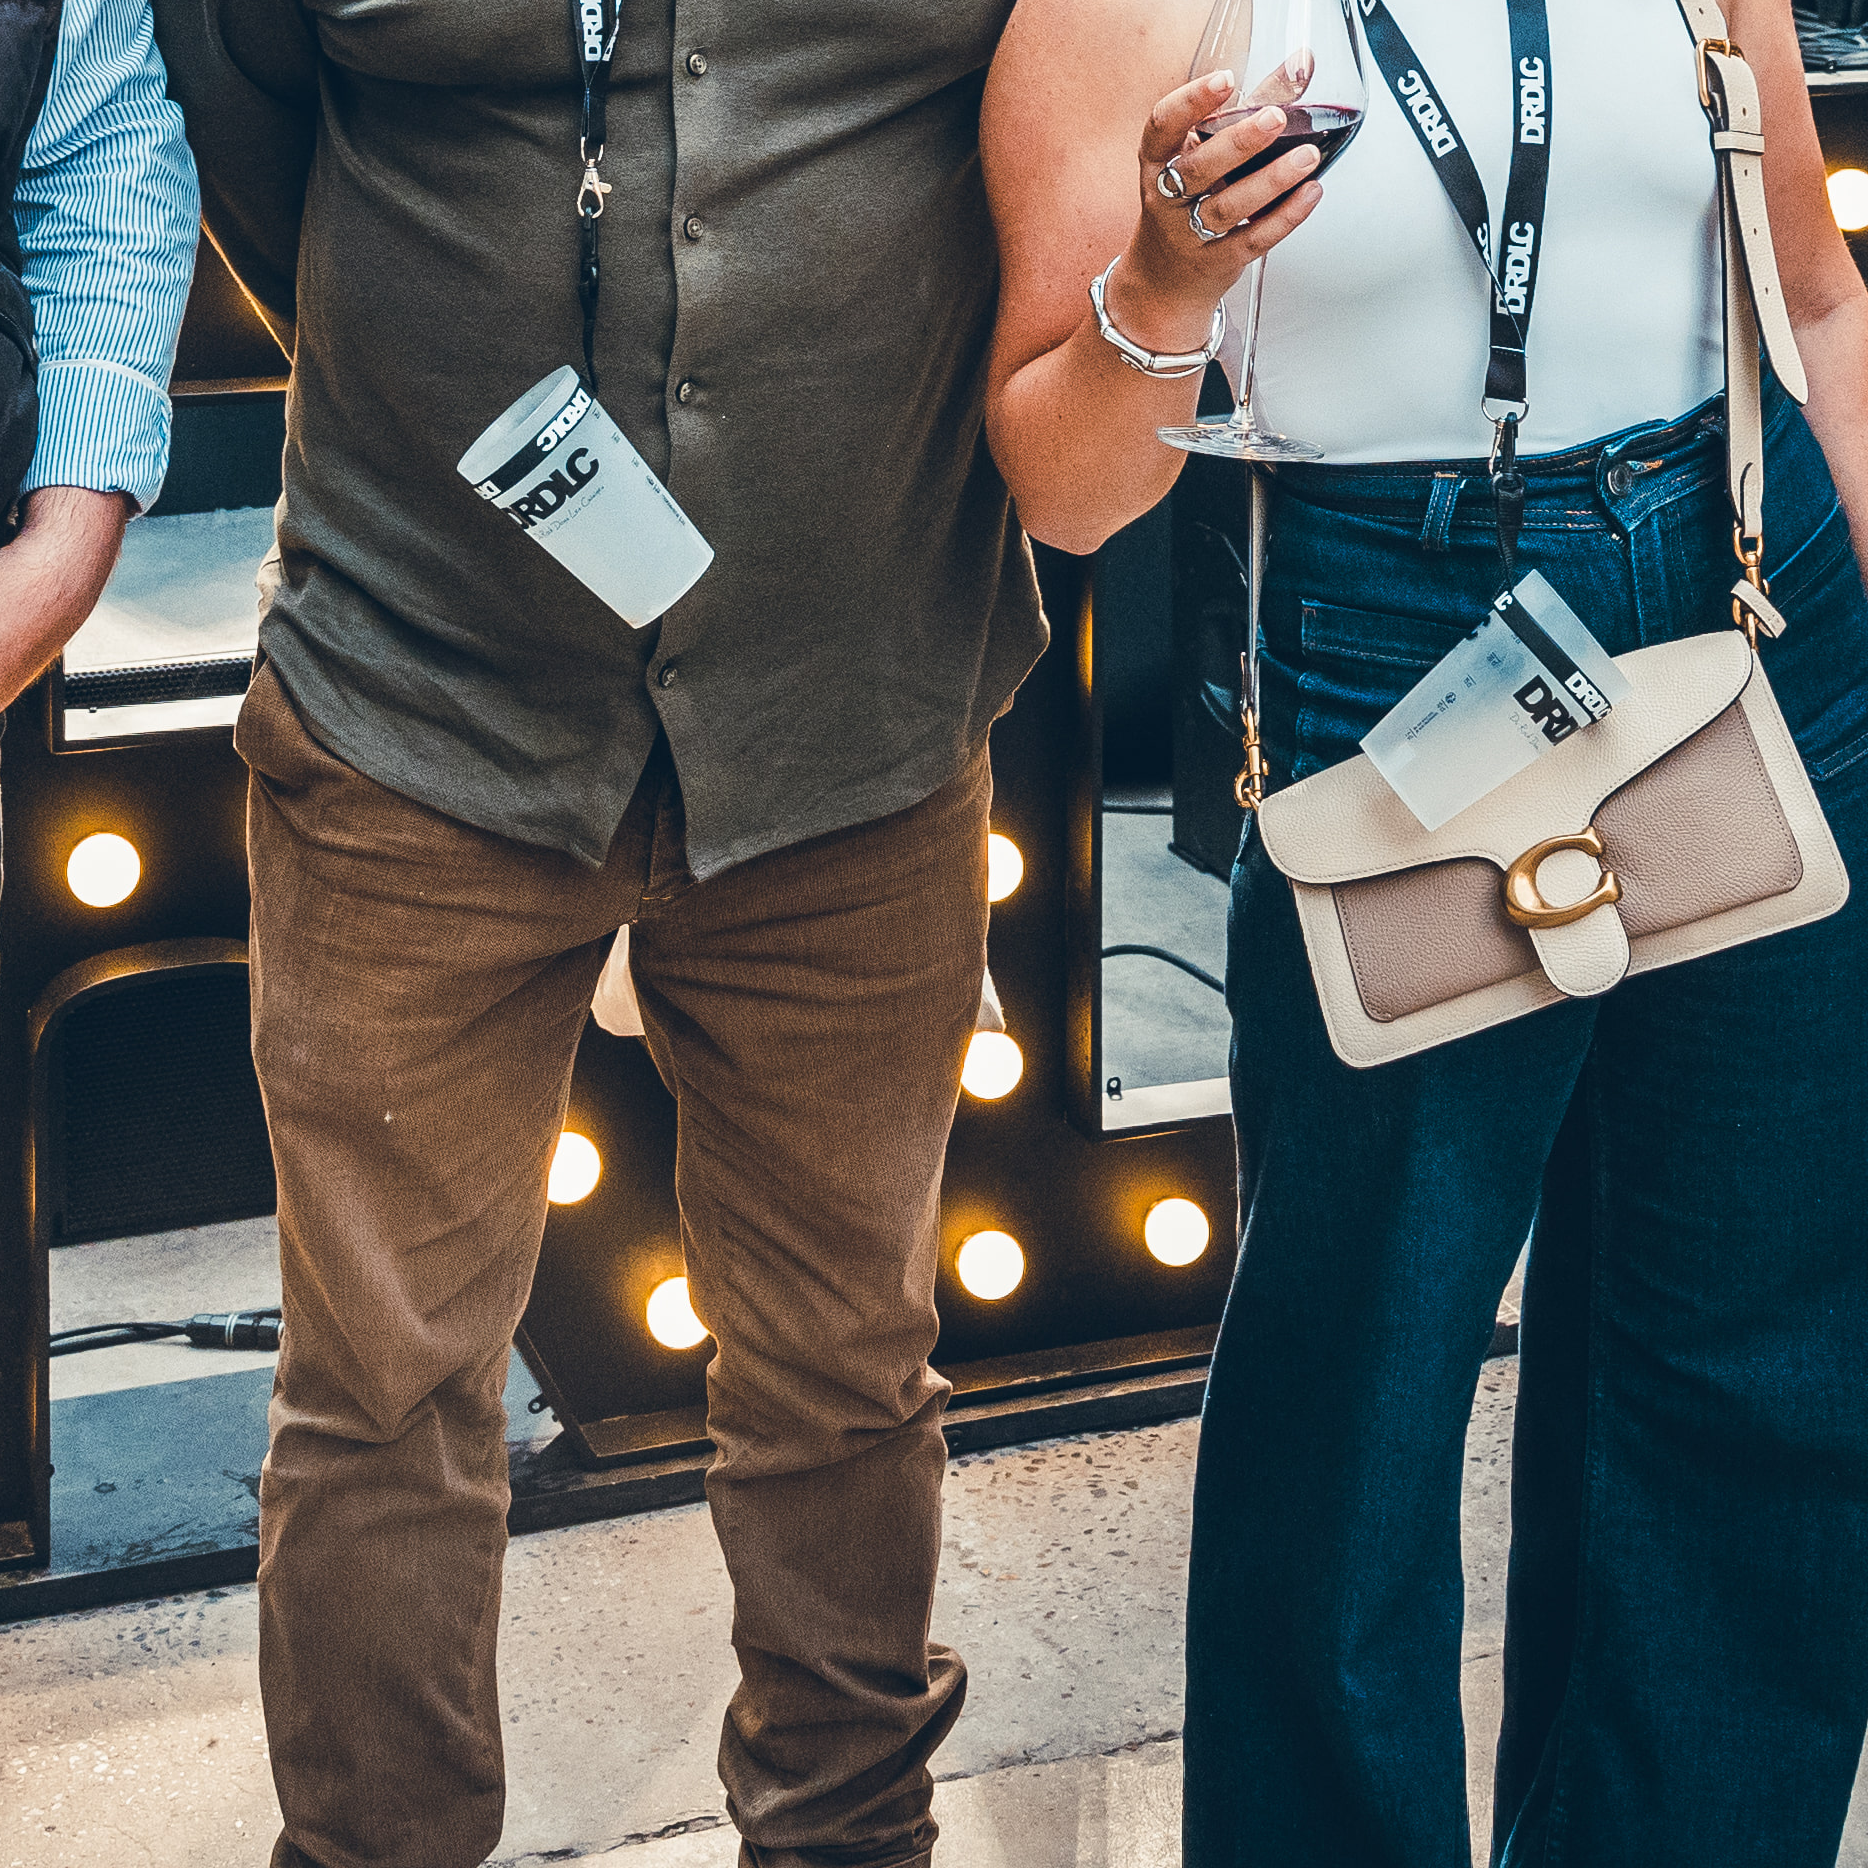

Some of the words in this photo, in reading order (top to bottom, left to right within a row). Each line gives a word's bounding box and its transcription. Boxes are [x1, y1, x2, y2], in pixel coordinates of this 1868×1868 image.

[1396, 68, 1458, 159] DRDLC
[1520, 55, 1547, 145] DRDLC
[1502, 221, 1535, 315] DRDLC
[536, 387, 593, 452] DRDLC
